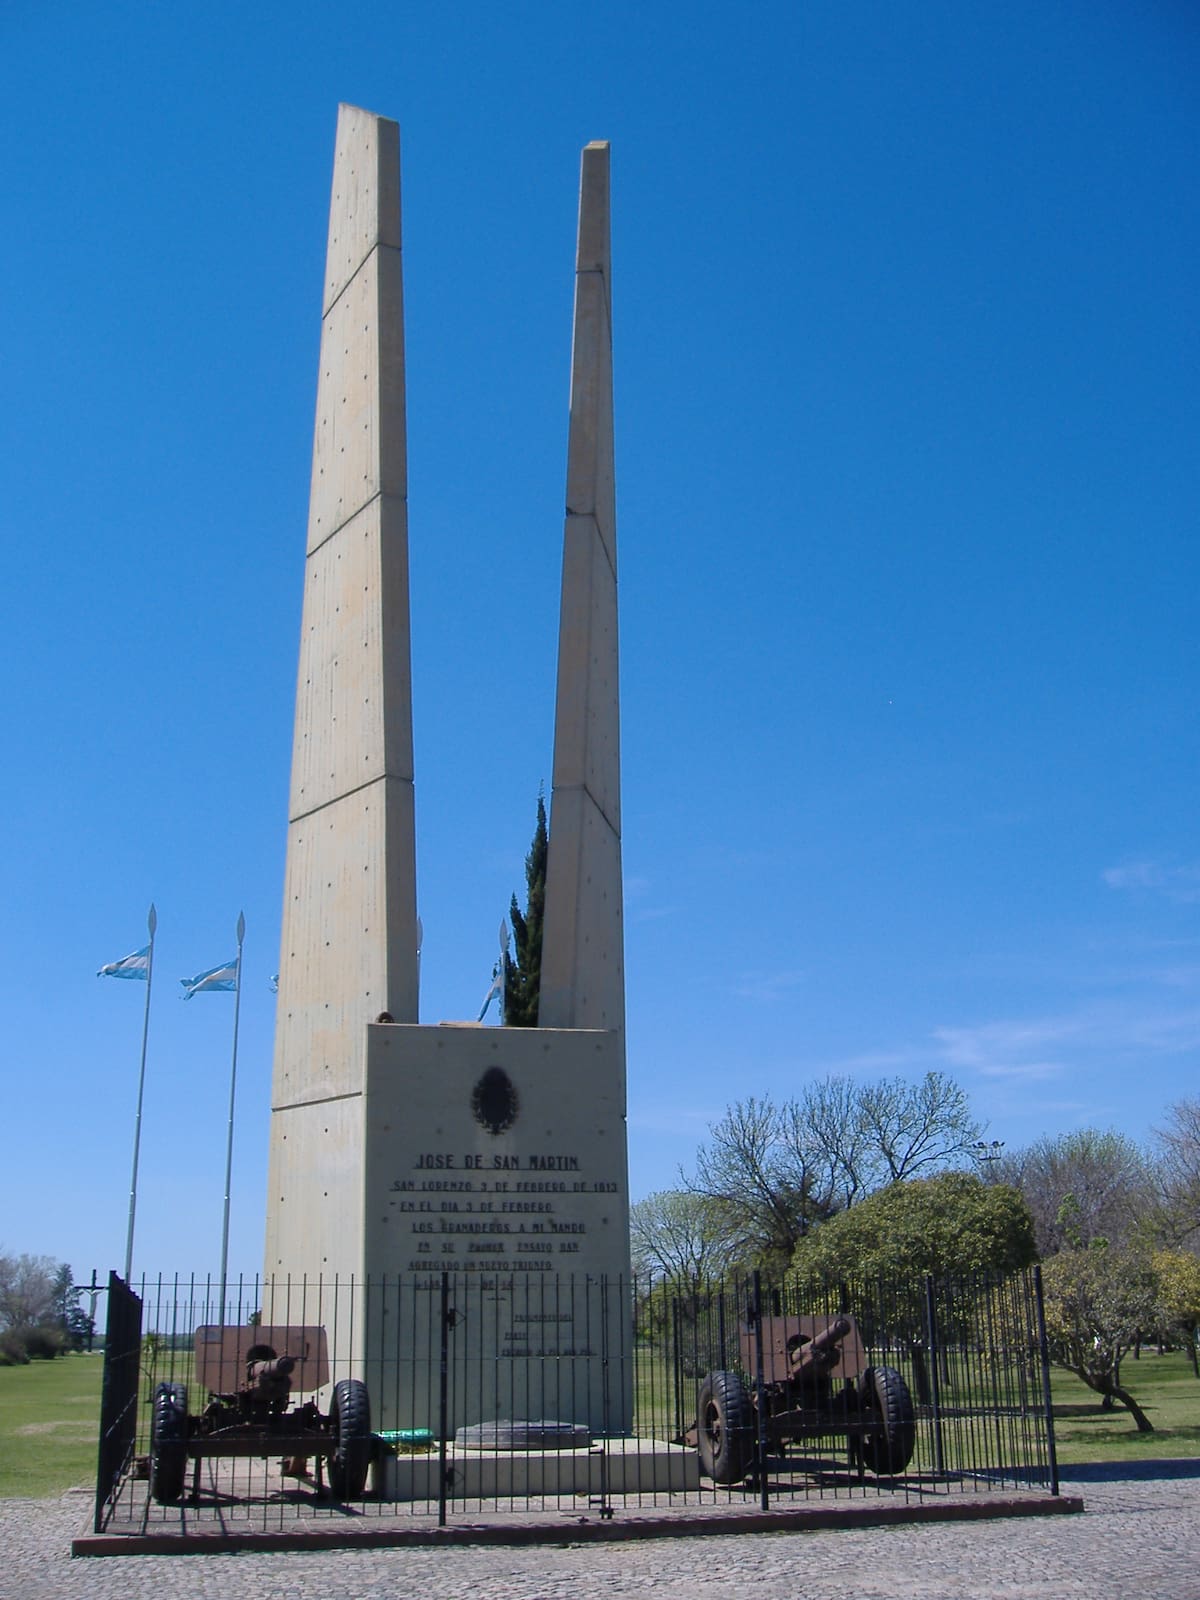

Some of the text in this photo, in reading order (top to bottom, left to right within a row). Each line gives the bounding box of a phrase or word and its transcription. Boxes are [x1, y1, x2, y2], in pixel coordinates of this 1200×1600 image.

[415, 1154, 579, 1170] JOSE DE SAN MARTIN
[393, 1180, 617, 1193] SAN LORENZO 3 DE FEBRERO DE 1813
[401, 1201, 552, 1213] EN EL DIA 3 DE FEBRERO
[413, 1222, 586, 1234] LOS GRANADEROS A MI MANDO
